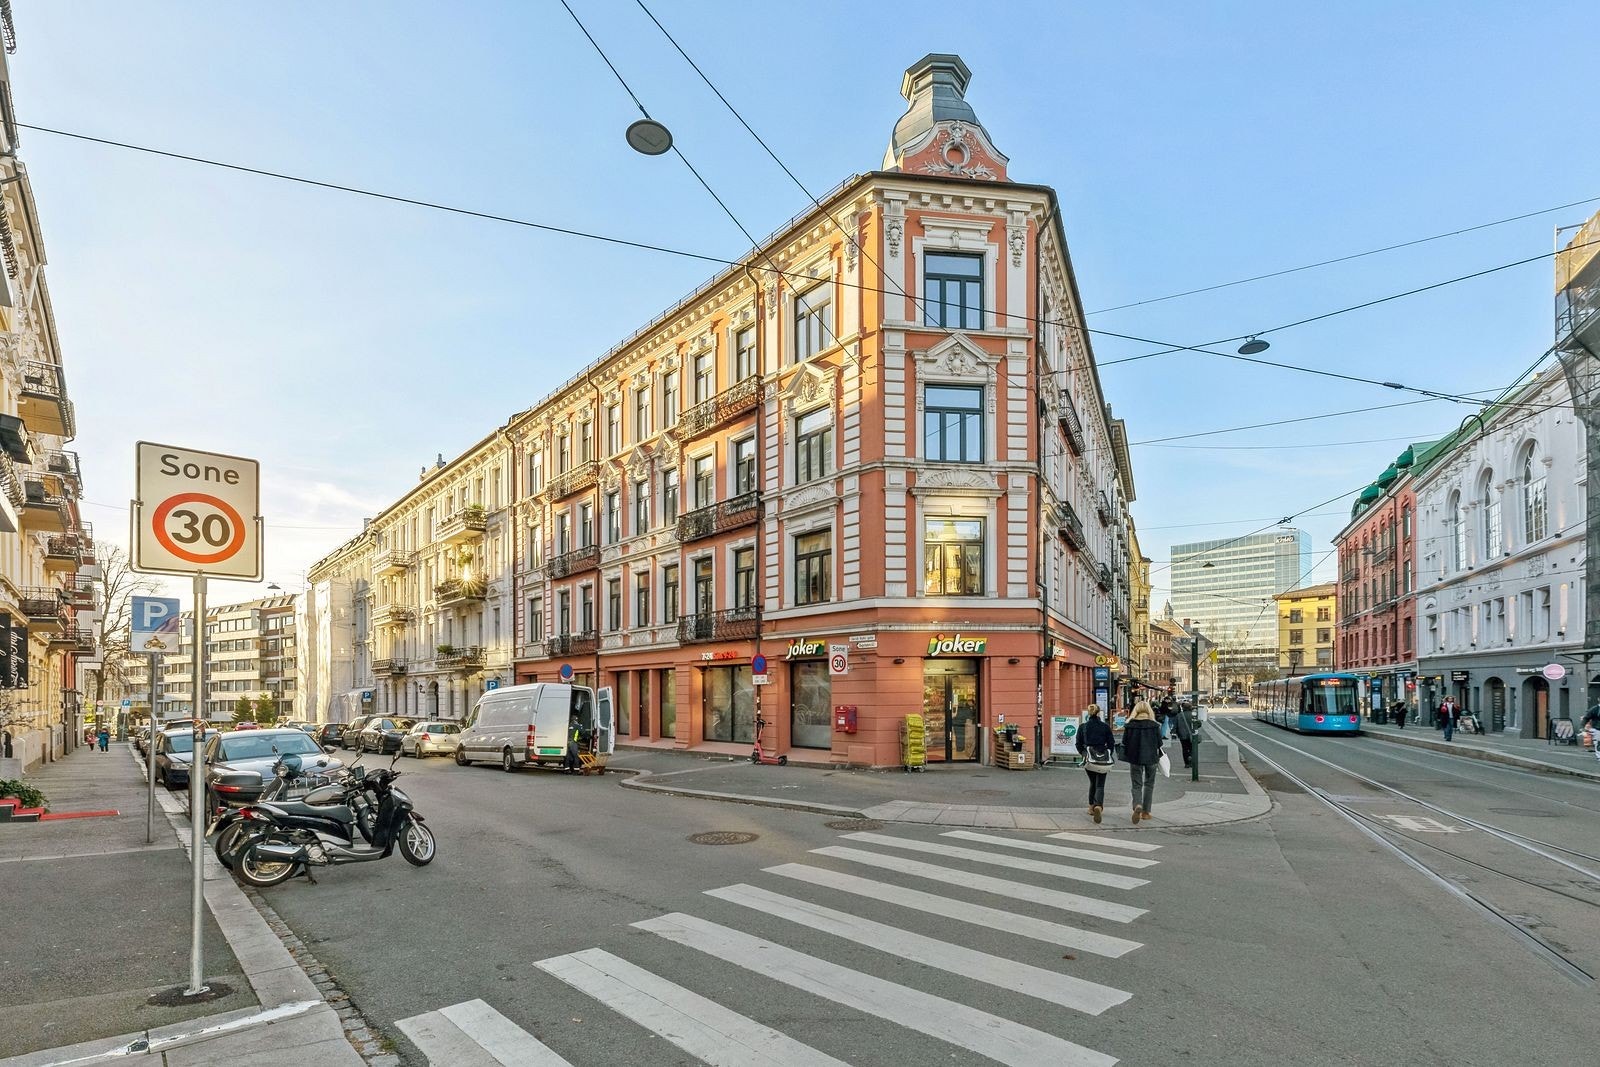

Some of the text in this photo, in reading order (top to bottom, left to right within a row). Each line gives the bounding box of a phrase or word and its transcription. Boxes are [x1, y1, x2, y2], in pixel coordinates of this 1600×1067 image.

[160, 453, 240, 485] Sone
[171, 509, 231, 547] 30
[143, 601, 168, 628] P
[785, 638, 820, 660] joker
[931, 633, 985, 657] joker
[834, 659, 844, 668] 30
[490, 682, 496, 690] P
